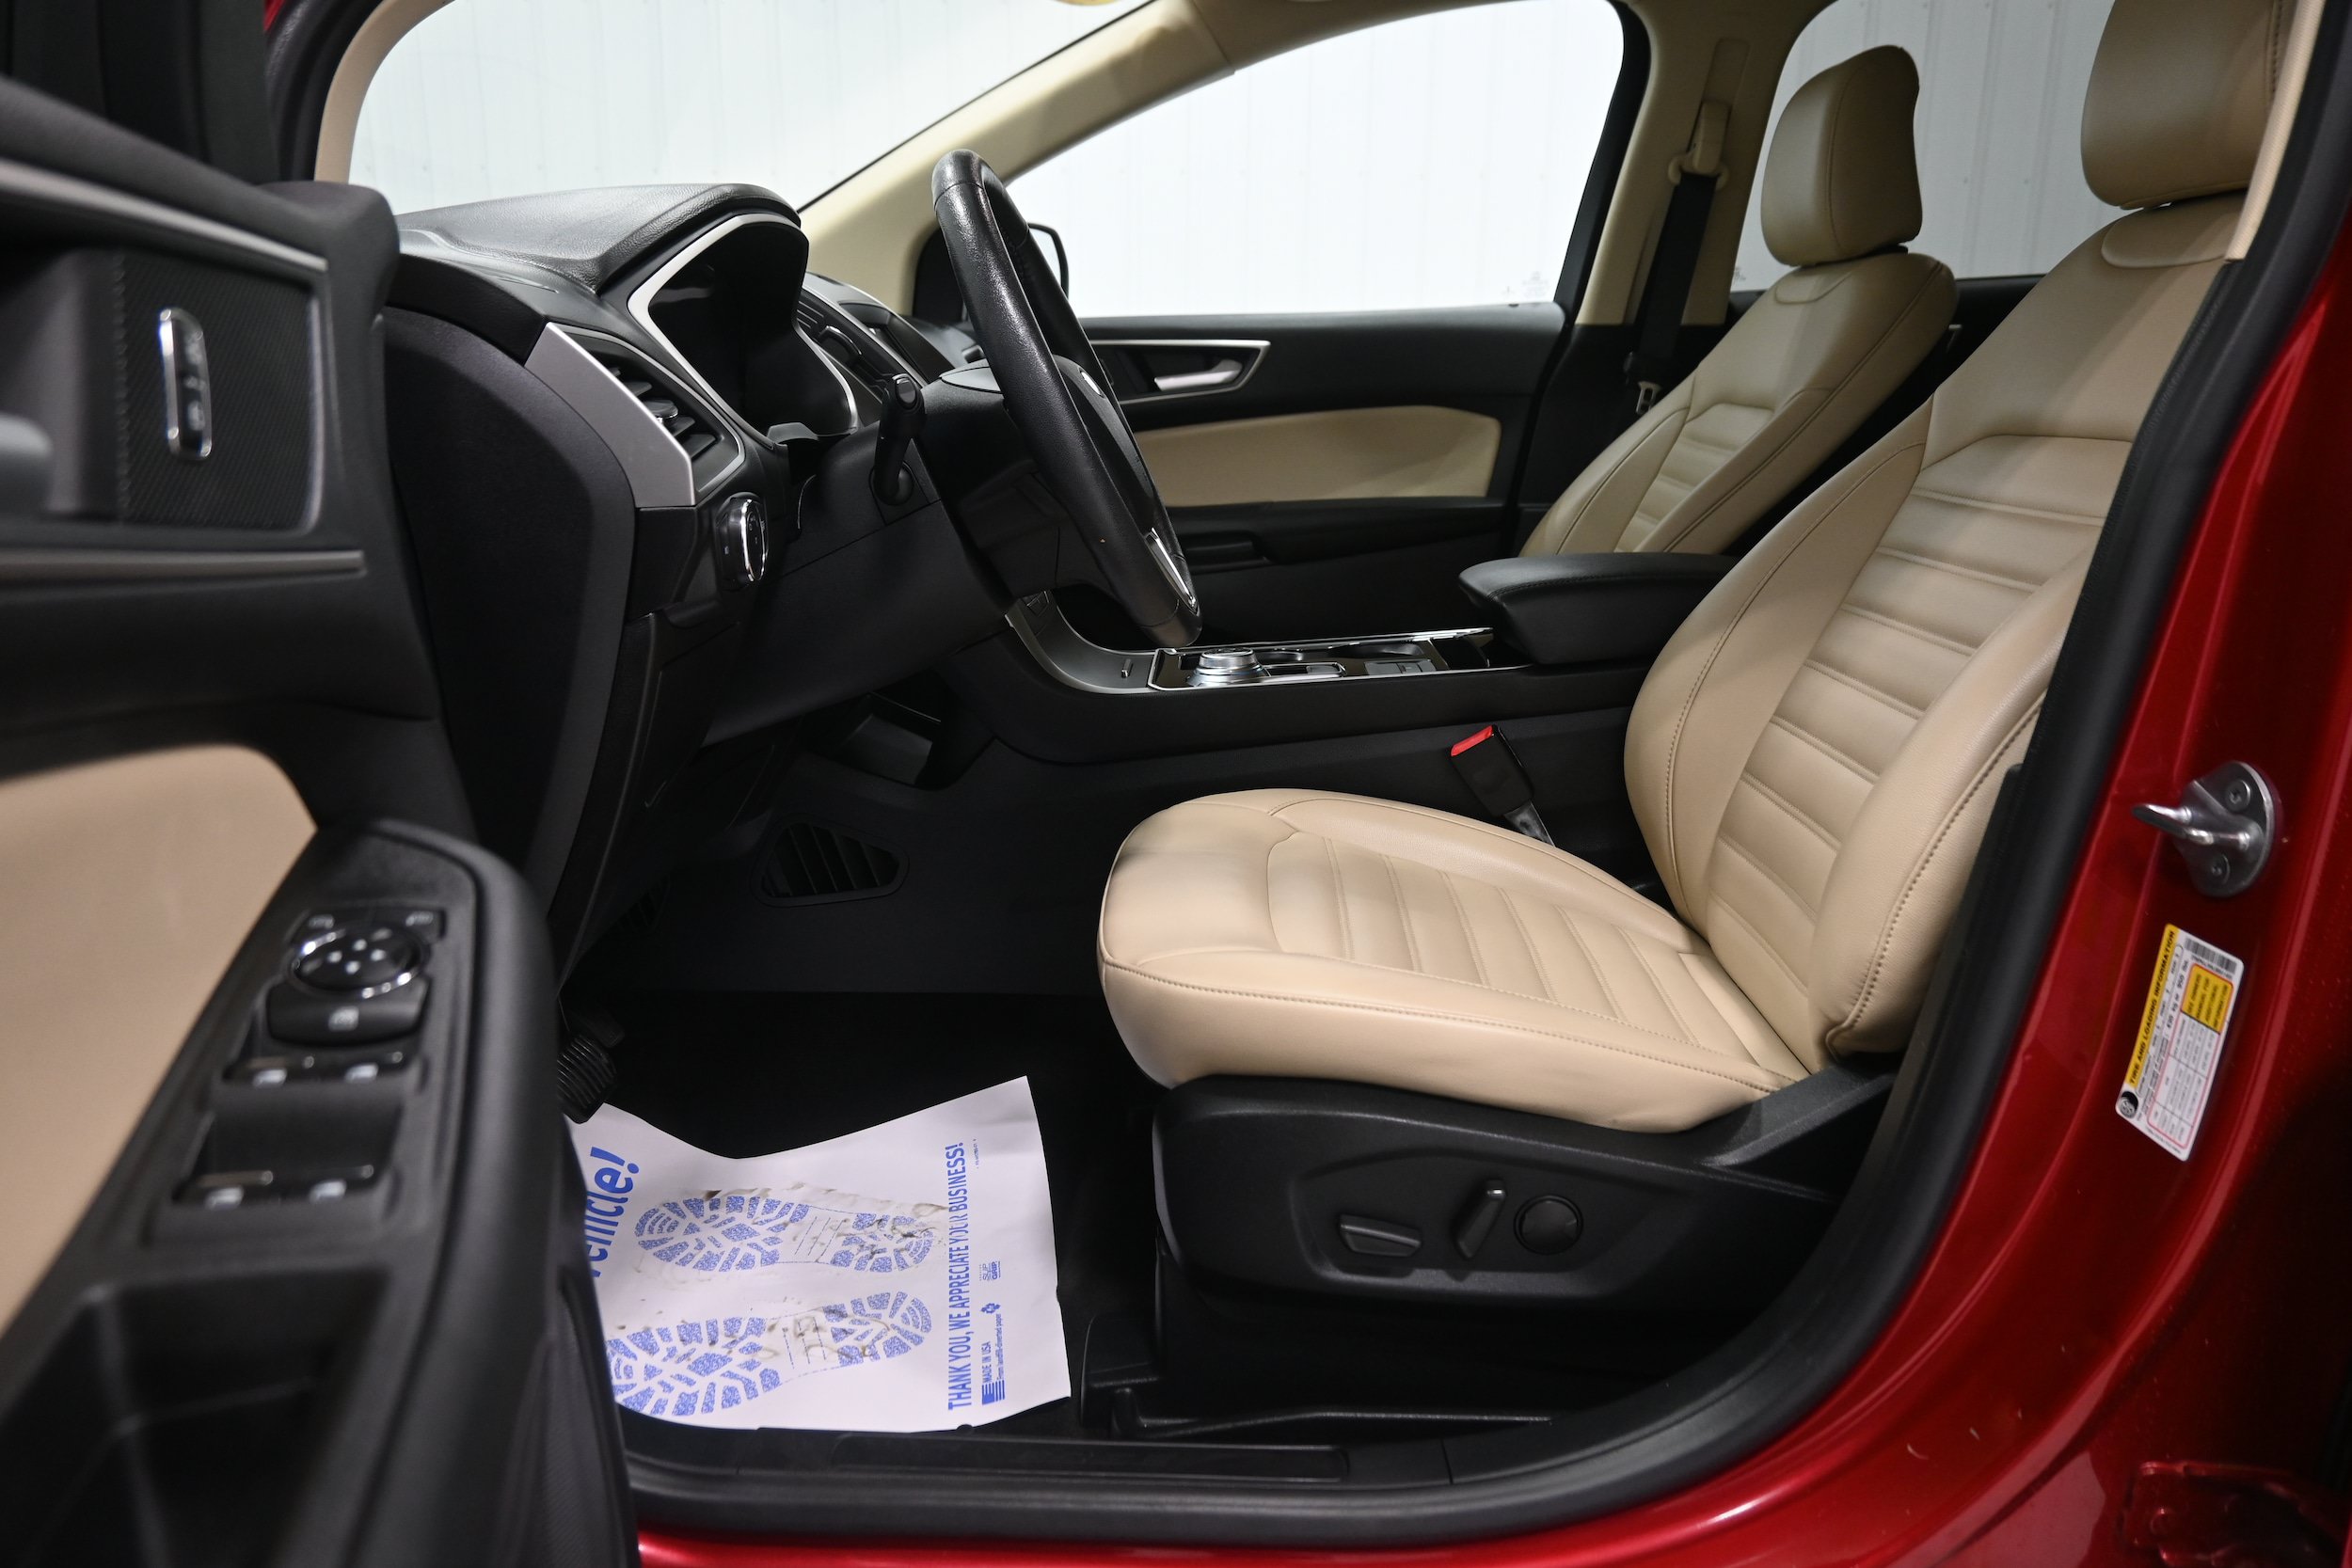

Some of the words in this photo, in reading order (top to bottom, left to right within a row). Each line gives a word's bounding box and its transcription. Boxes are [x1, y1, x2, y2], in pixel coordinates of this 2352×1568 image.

[2128, 1063, 2139, 1085] TIRE
[2137, 1042, 2146, 1062] AND
[2143, 999, 2157, 1040] LOADING
[2153, 930, 2175, 996] INFORMATION
[945, 1142, 968, 1212] BUSINESS!
[948, 1213, 969, 1244] YOUR
[947, 1245, 971, 1308] APPRECIATE
[948, 1311, 971, 1331] WE
[948, 1331, 974, 1363] YOU,
[981, 1341, 992, 1355] USA
[947, 1363, 972, 1410] THANK
[981, 1364, 993, 1384] MADE
